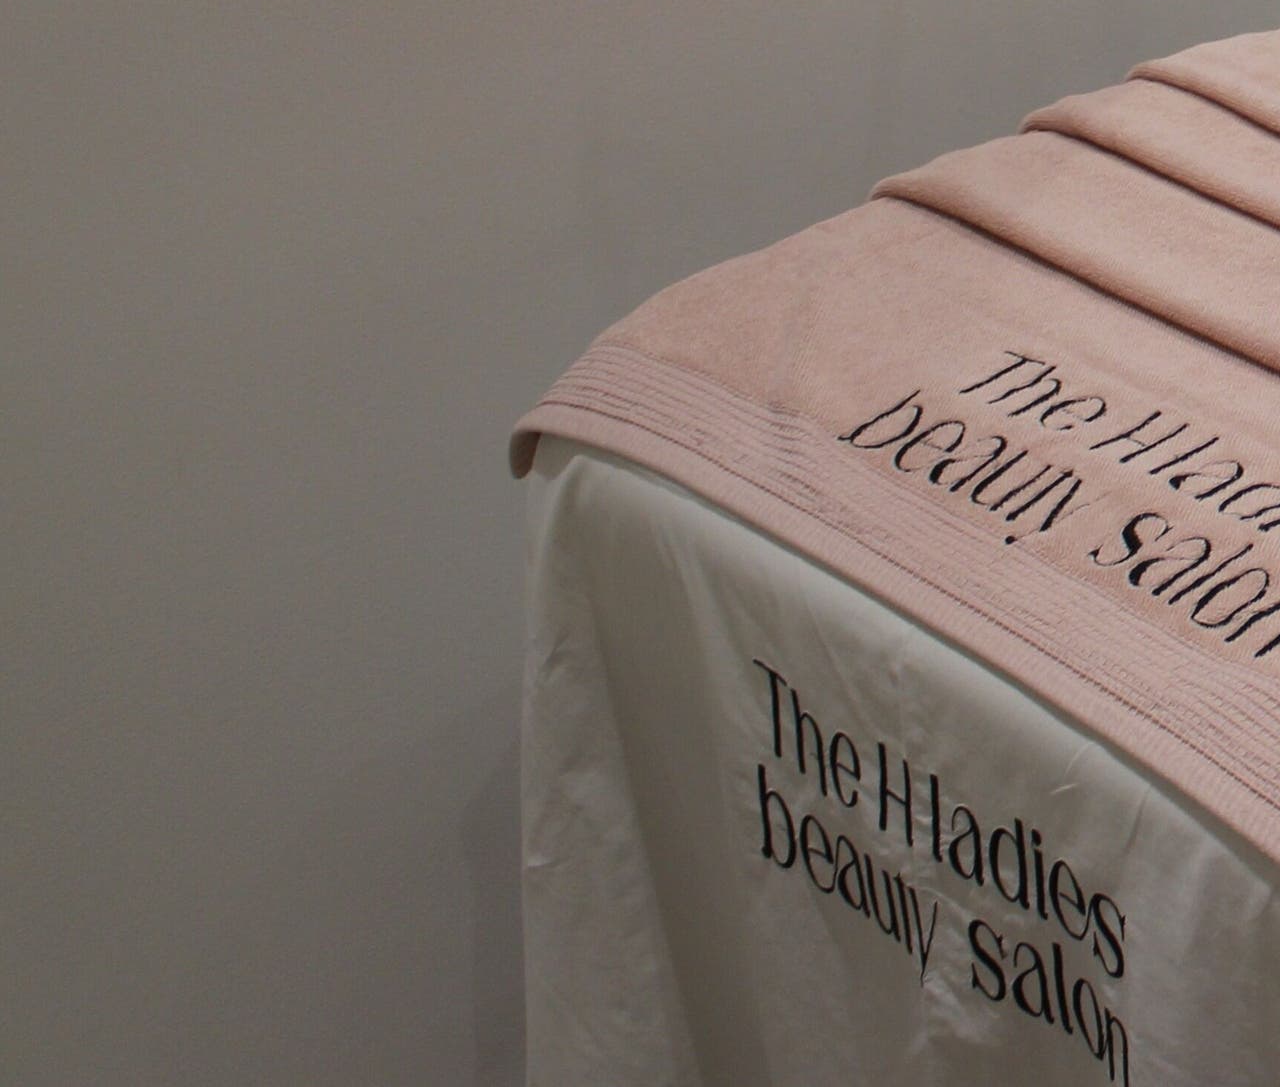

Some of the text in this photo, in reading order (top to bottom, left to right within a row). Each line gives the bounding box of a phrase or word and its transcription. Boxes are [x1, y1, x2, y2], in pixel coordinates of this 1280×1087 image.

[958, 350, 1108, 431] The
[752, 658, 862, 808] The
[967, 918, 1130, 1087] salon
